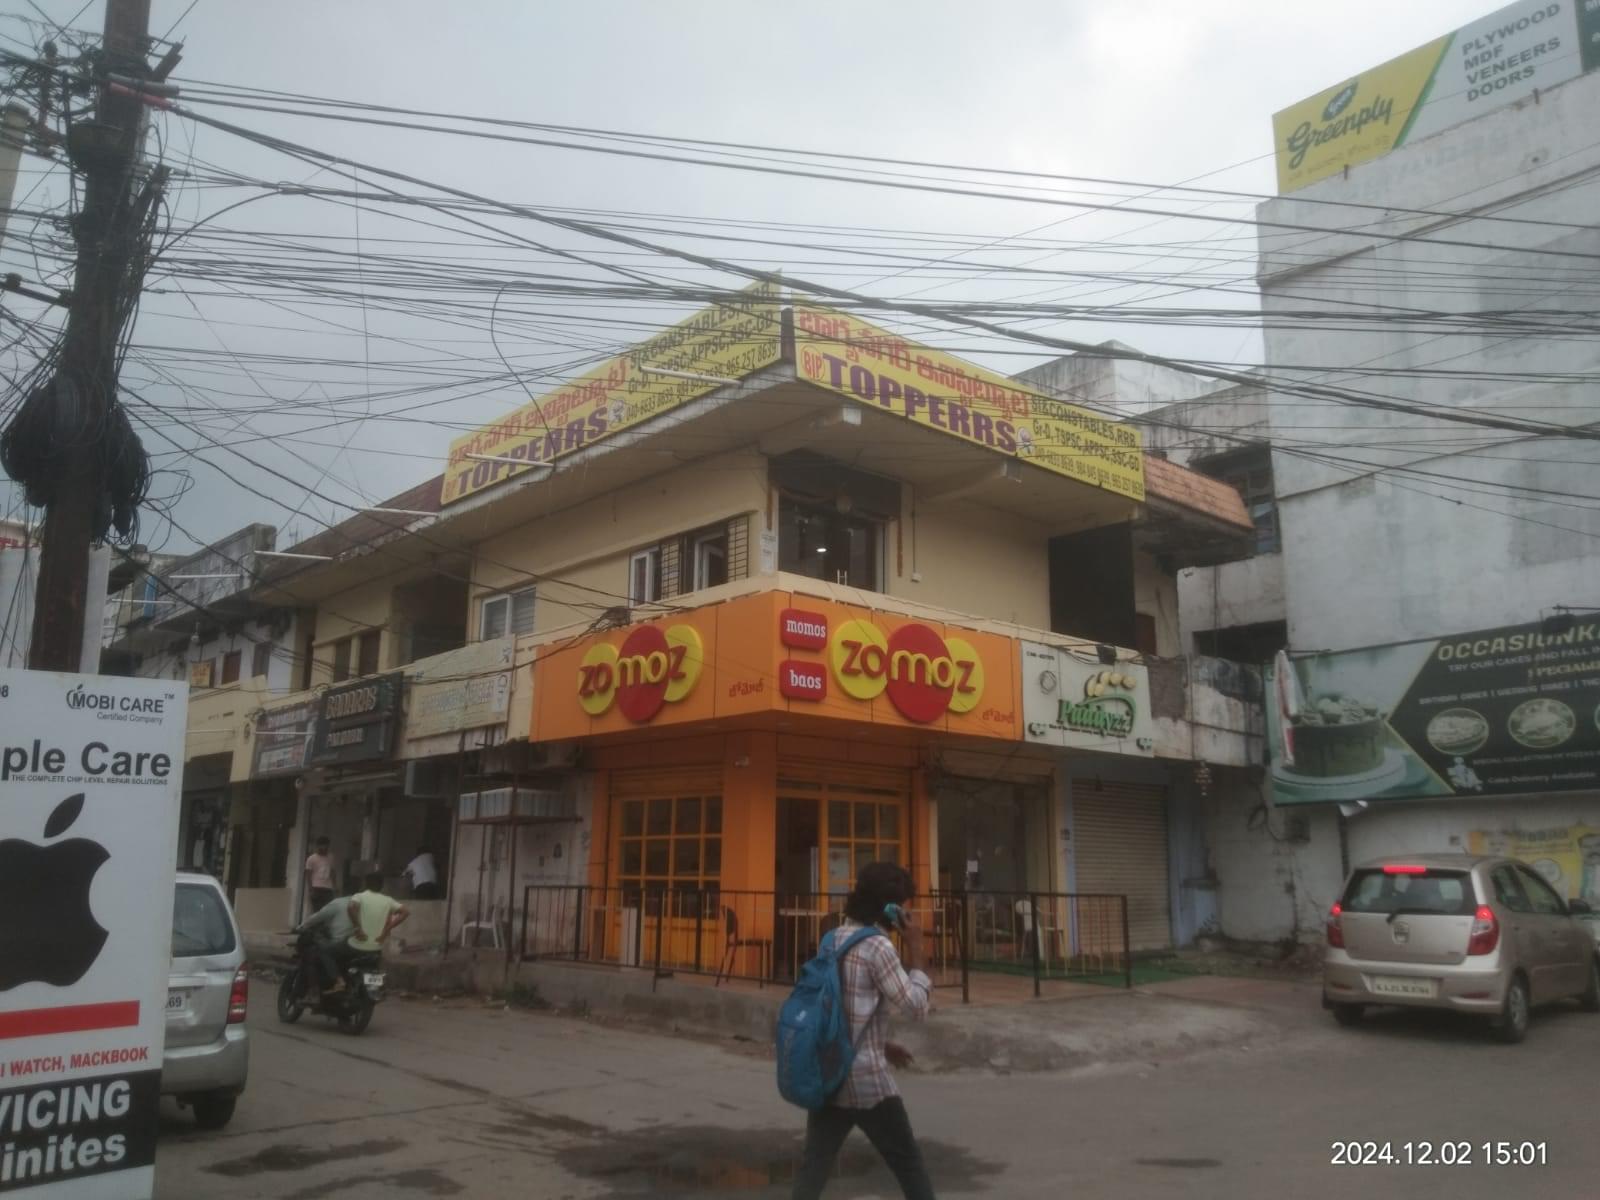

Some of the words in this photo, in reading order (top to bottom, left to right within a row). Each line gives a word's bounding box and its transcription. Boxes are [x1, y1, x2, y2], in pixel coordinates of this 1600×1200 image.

[1462, 4, 1560, 55] PLYWOOD
[1463, 44, 1504, 71] MDF
[1466, 37, 1561, 85] VENEERS
[1467, 65, 1536, 101] DOORS
[1287, 95, 1394, 169] Greenply
[822, 351, 1018, 455] TOPPERRS
[786, 618, 826, 639] momos
[789, 669, 822, 690] baos
[68, 690, 116, 711] MOBI
[119, 697, 164, 713] CARE
[97, 711, 128, 722] Certified
[129, 714, 163, 725] Company
[81, 741, 171, 778] Care
[12, 774, 25, 782] THE
[26, 775, 65, 783] COMPLETE
[67, 775, 83, 783] CHIP
[84, 776, 105, 784] LEVEL
[106, 777, 130, 785] REPAIR
[10, 1055, 65, 1077] WATCH,
[70, 1046, 149, 1069] MACKBOOK
